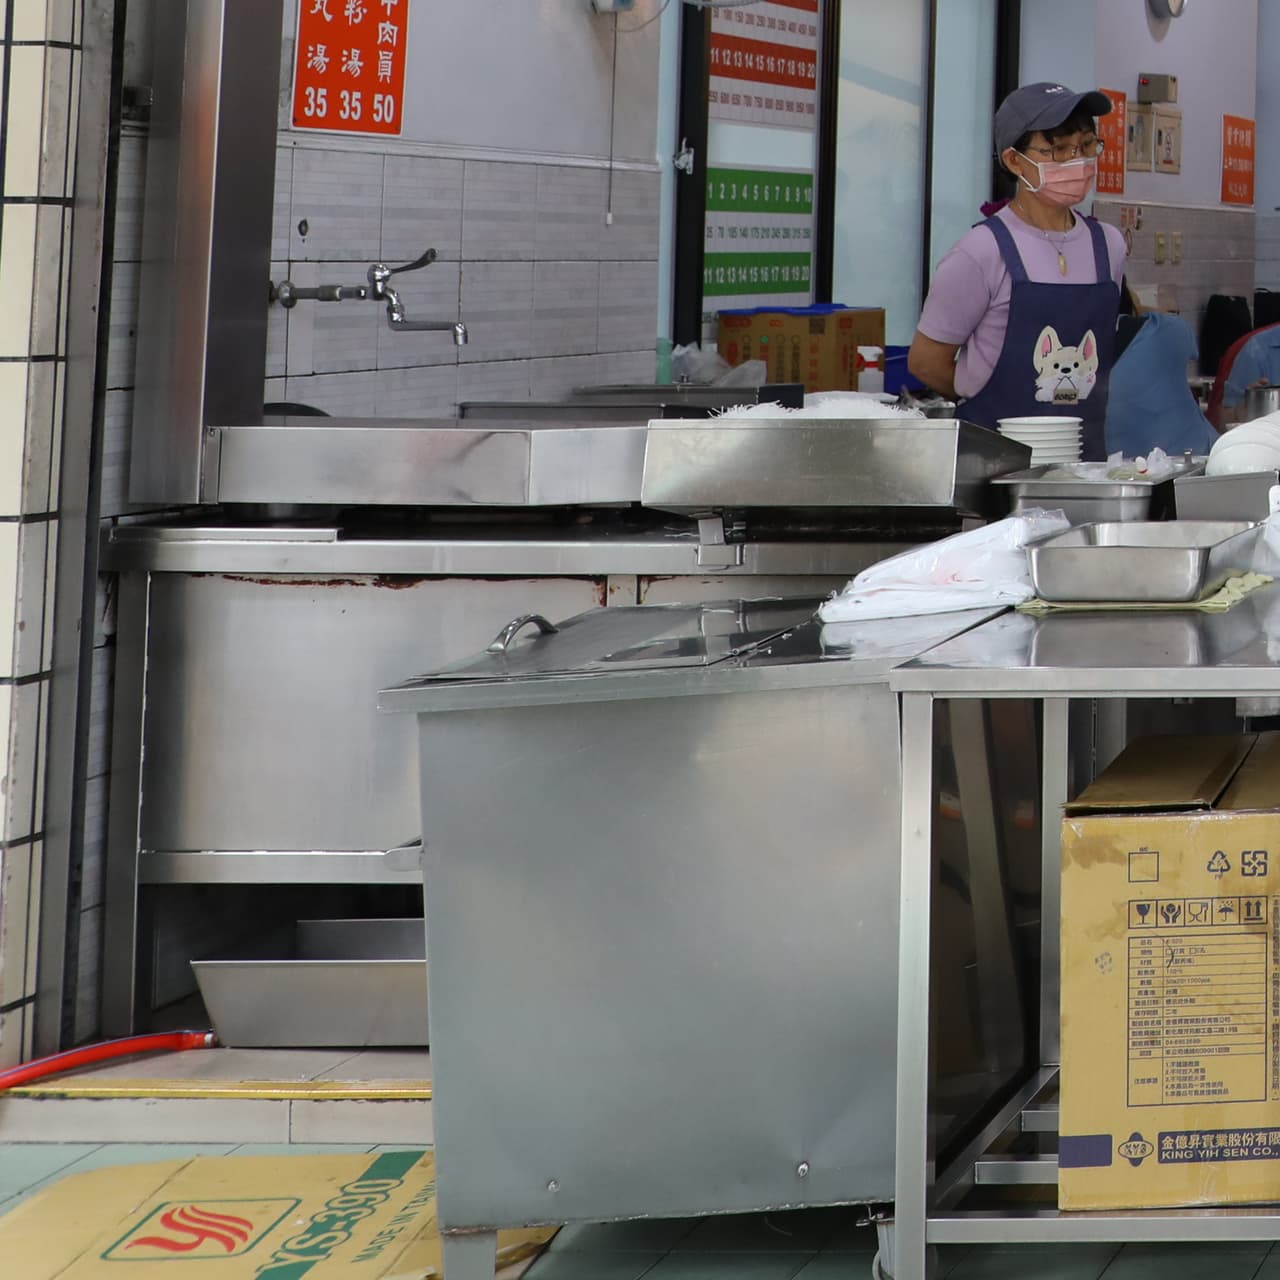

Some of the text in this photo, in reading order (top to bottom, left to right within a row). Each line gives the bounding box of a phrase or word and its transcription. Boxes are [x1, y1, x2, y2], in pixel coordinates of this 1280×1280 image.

[304, 86, 327, 118] 35
[339, 90, 362, 120] 35
[373, 93, 395, 124] 50
[1162, 1149, 1193, 1160] KING
[1198, 1149, 1218, 1159] YIH
[1223, 1148, 1248, 1158] SEN
[351, 1227, 406, 1264] MADE
